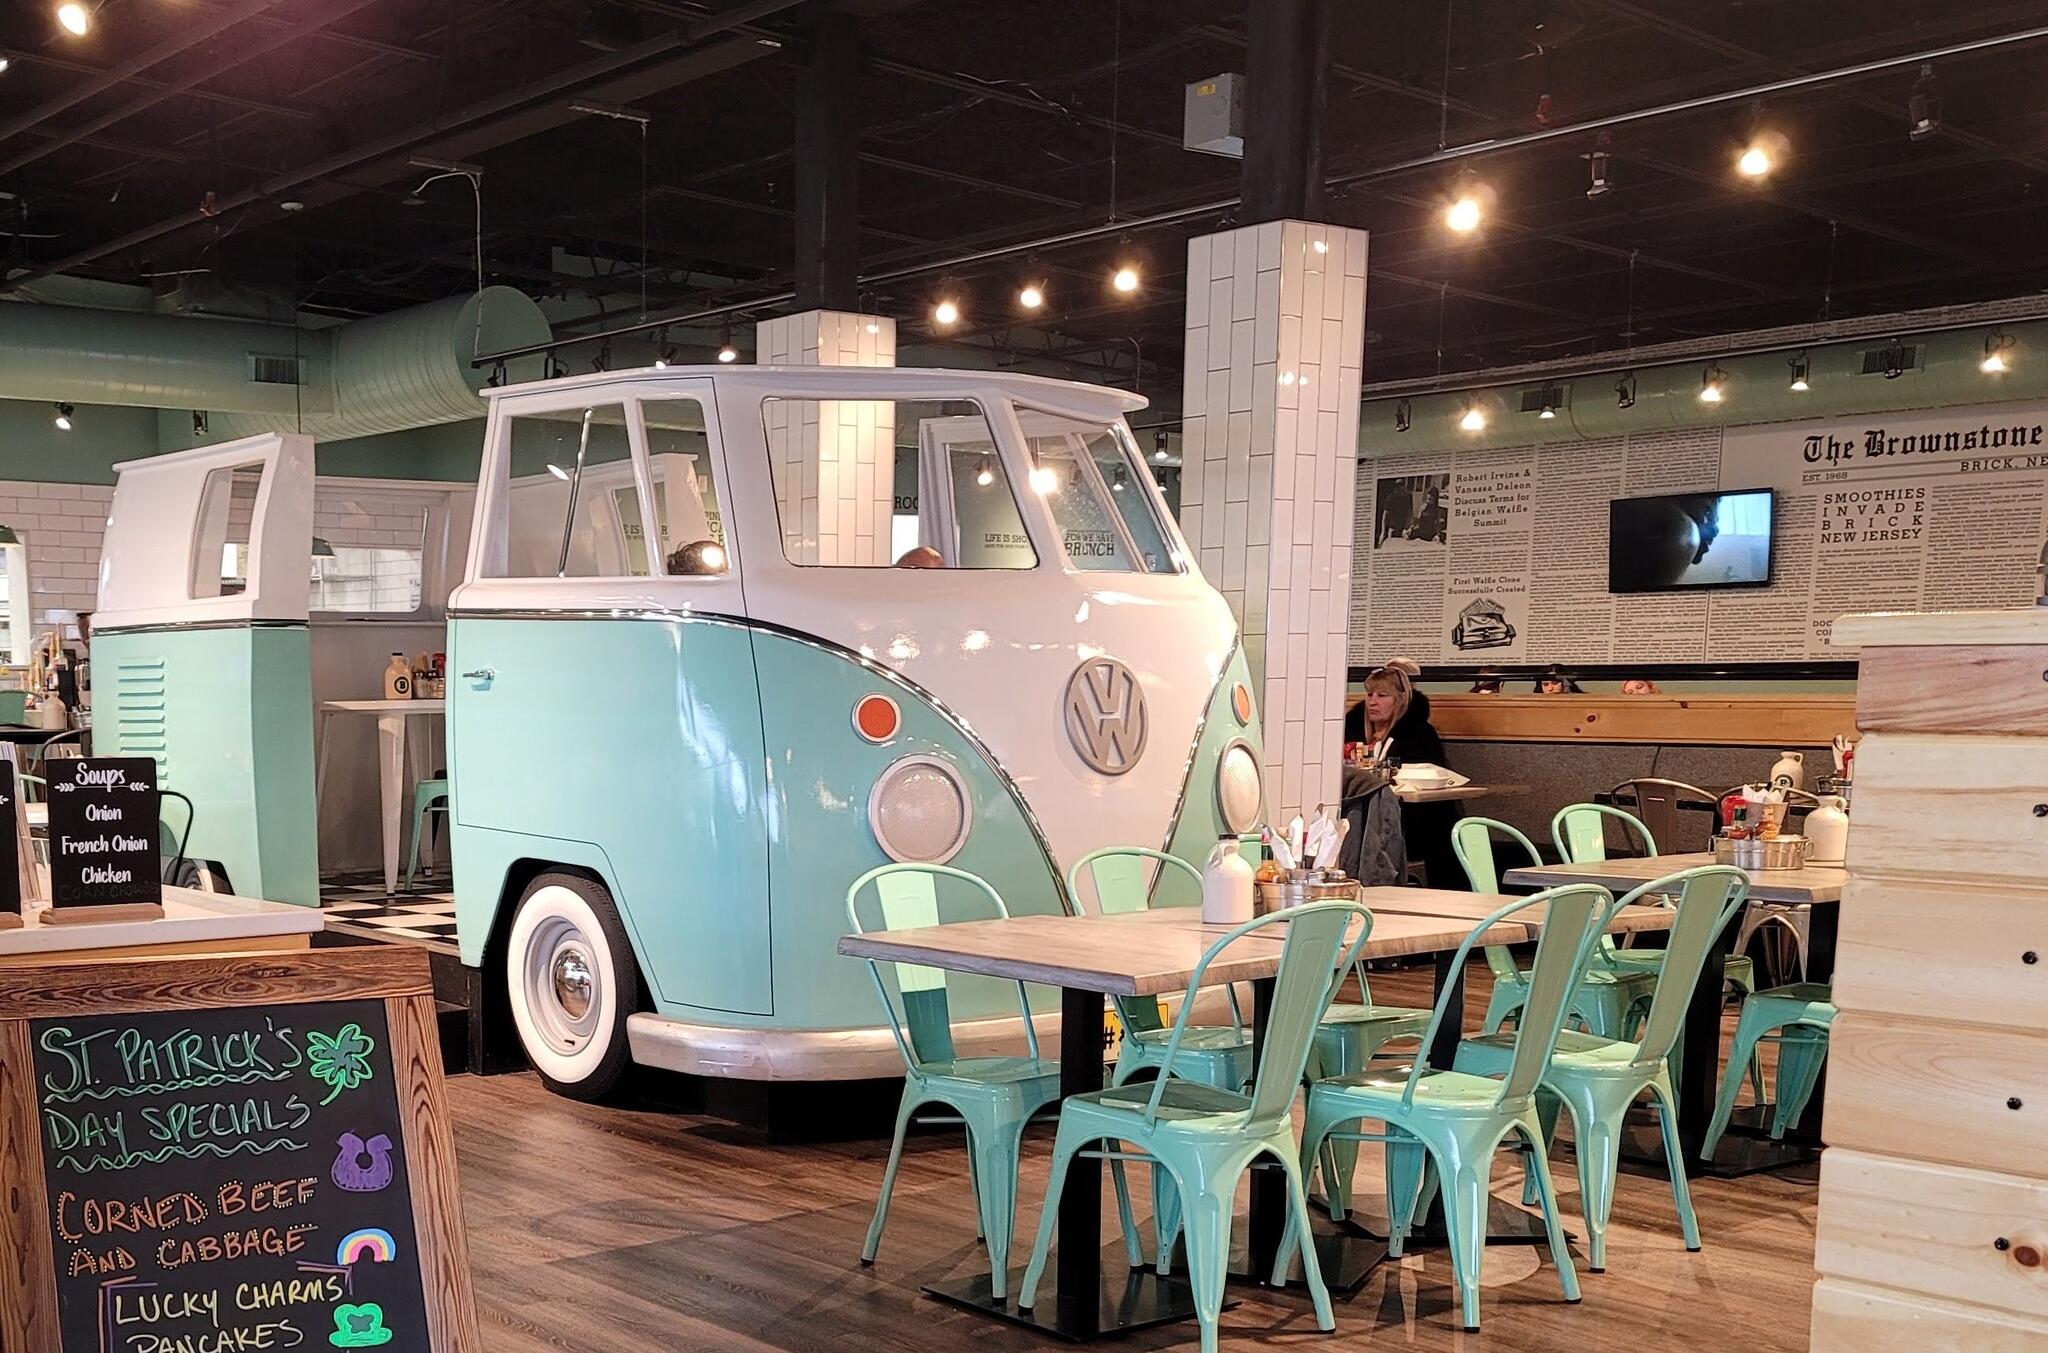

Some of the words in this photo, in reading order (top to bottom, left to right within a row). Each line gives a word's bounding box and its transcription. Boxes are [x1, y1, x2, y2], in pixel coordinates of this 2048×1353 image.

[1803, 434, 1855, 466] The
[1864, 424, 2043, 458] Brownstone
[1960, 458, 2018, 472] BRICK,
[1456, 473, 1487, 482] Robert
[1490, 471, 1519, 480] Irvine
[1523, 468, 1531, 477] &
[1455, 485, 1492, 493] Vanessa
[1496, 481, 1531, 491] Deleon
[1455, 497, 1486, 505] Discuss
[1489, 494, 1514, 503] Terms
[1824, 488, 1926, 504] SMOOTHIES
[1455, 508, 1492, 517] Belgian
[1497, 505, 1528, 514] Waffle
[1823, 502, 1925, 517] INVADE
[1474, 519, 1507, 527] Summit
[1822, 515, 1923, 530] BRICK
[985, 533, 1001, 542] LIFE
[1003, 534, 1010, 542] IS
[1820, 531, 1856, 543] NEW
[1862, 529, 1922, 541] JERSEY
[1065, 542, 1114, 556] BRUNCH
[1496, 585, 1526, 593] Created
[1064, 656, 1148, 776] VW
[75, 762, 126, 792] Soups
[85, 803, 122, 822] Onion
[61, 835, 109, 855] French
[111, 834, 148, 852] Onion
[81, 863, 132, 884] Chicken
[40, 1027, 117, 1092] ST.
[114, 1016, 302, 1083] PATRICK'S
[44, 1108, 129, 1158] DAY
[141, 1095, 311, 1142] SPECIALS
[56, 1191, 208, 1243] CORNED
[217, 1177, 319, 1215] BEEF
[68, 1247, 136, 1276] AND
[156, 1223, 319, 1269] CABBAGE
[115, 1290, 218, 1328] LUCKY
[235, 1275, 344, 1309] CHARMS
[125, 1319, 304, 1353] PANCAKES
